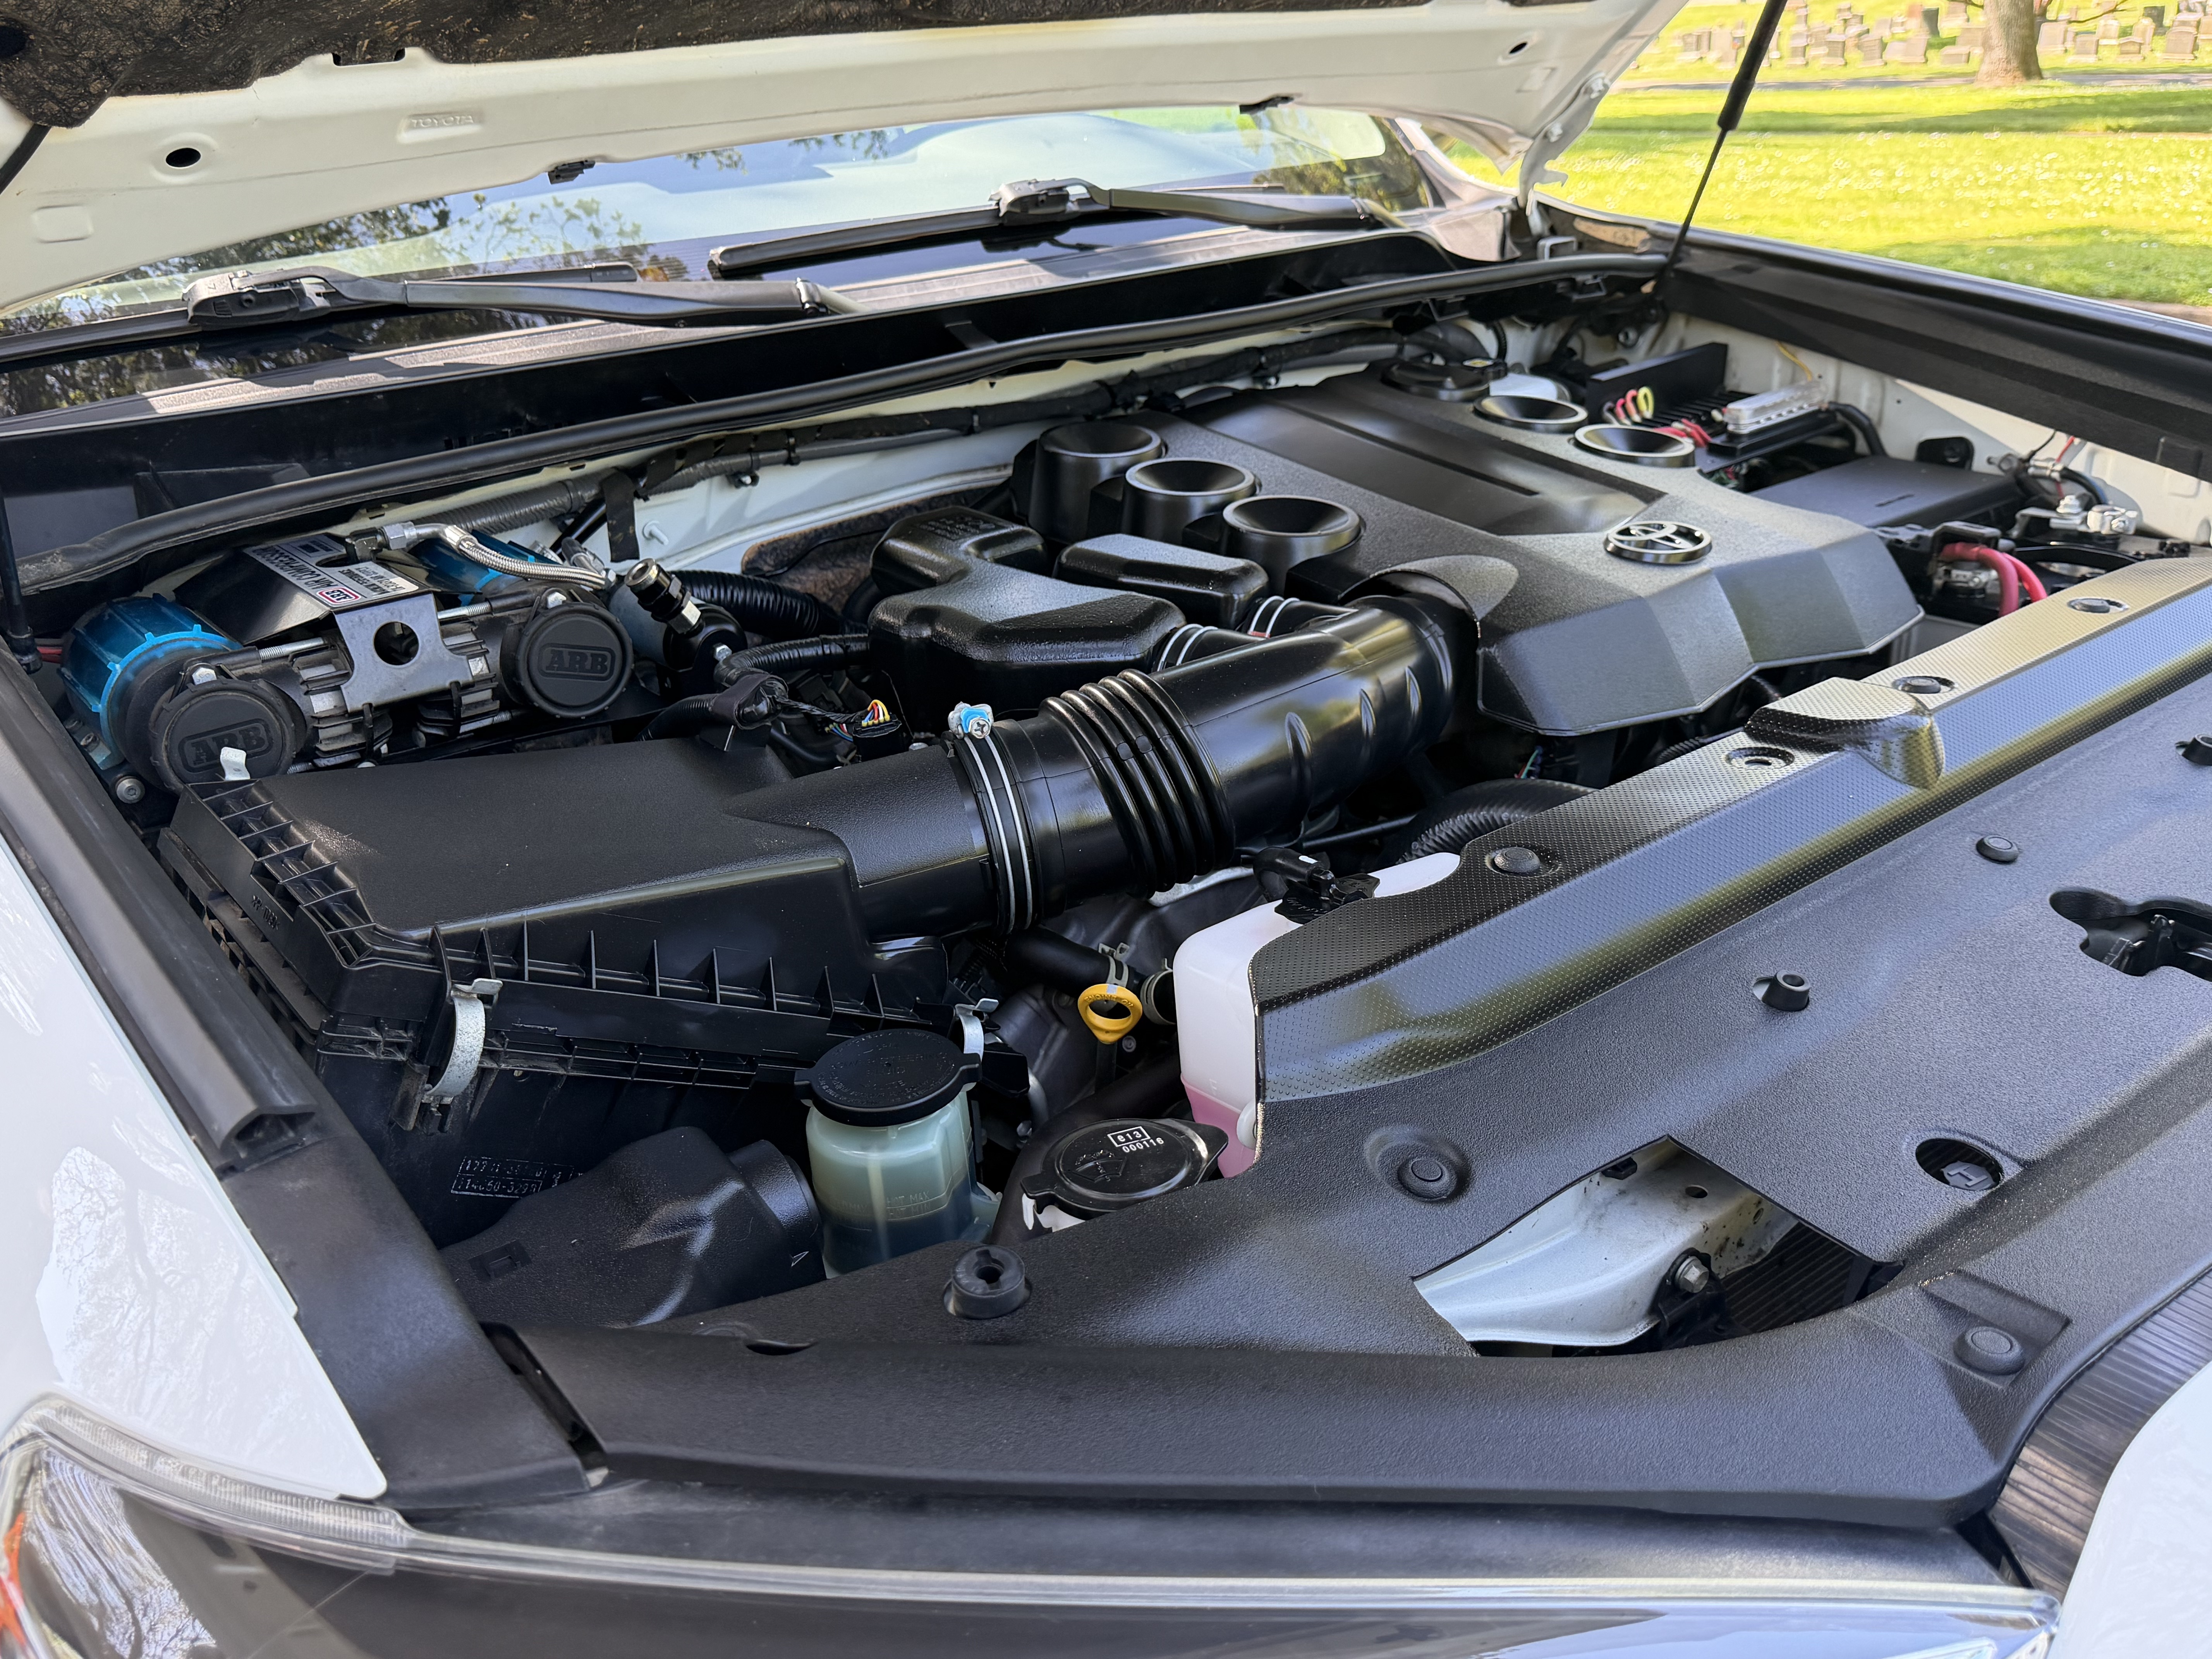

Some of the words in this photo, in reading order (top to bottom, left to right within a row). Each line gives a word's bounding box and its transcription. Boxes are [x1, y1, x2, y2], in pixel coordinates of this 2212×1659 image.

[410, 115, 474, 128] TOYOTA
[304, 577, 338, 589] AIR
[325, 589, 354, 601] ARB
[545, 649, 608, 675] ARB
[191, 726, 265, 766] ARB
[1084, 994, 1117, 1003] ENGINE
[1121, 999, 1134, 1008] OIL
[1117, 1131, 1142, 1142] e13
[886, 1195, 905, 1205] HOT
[910, 1191, 930, 1204] MAX
